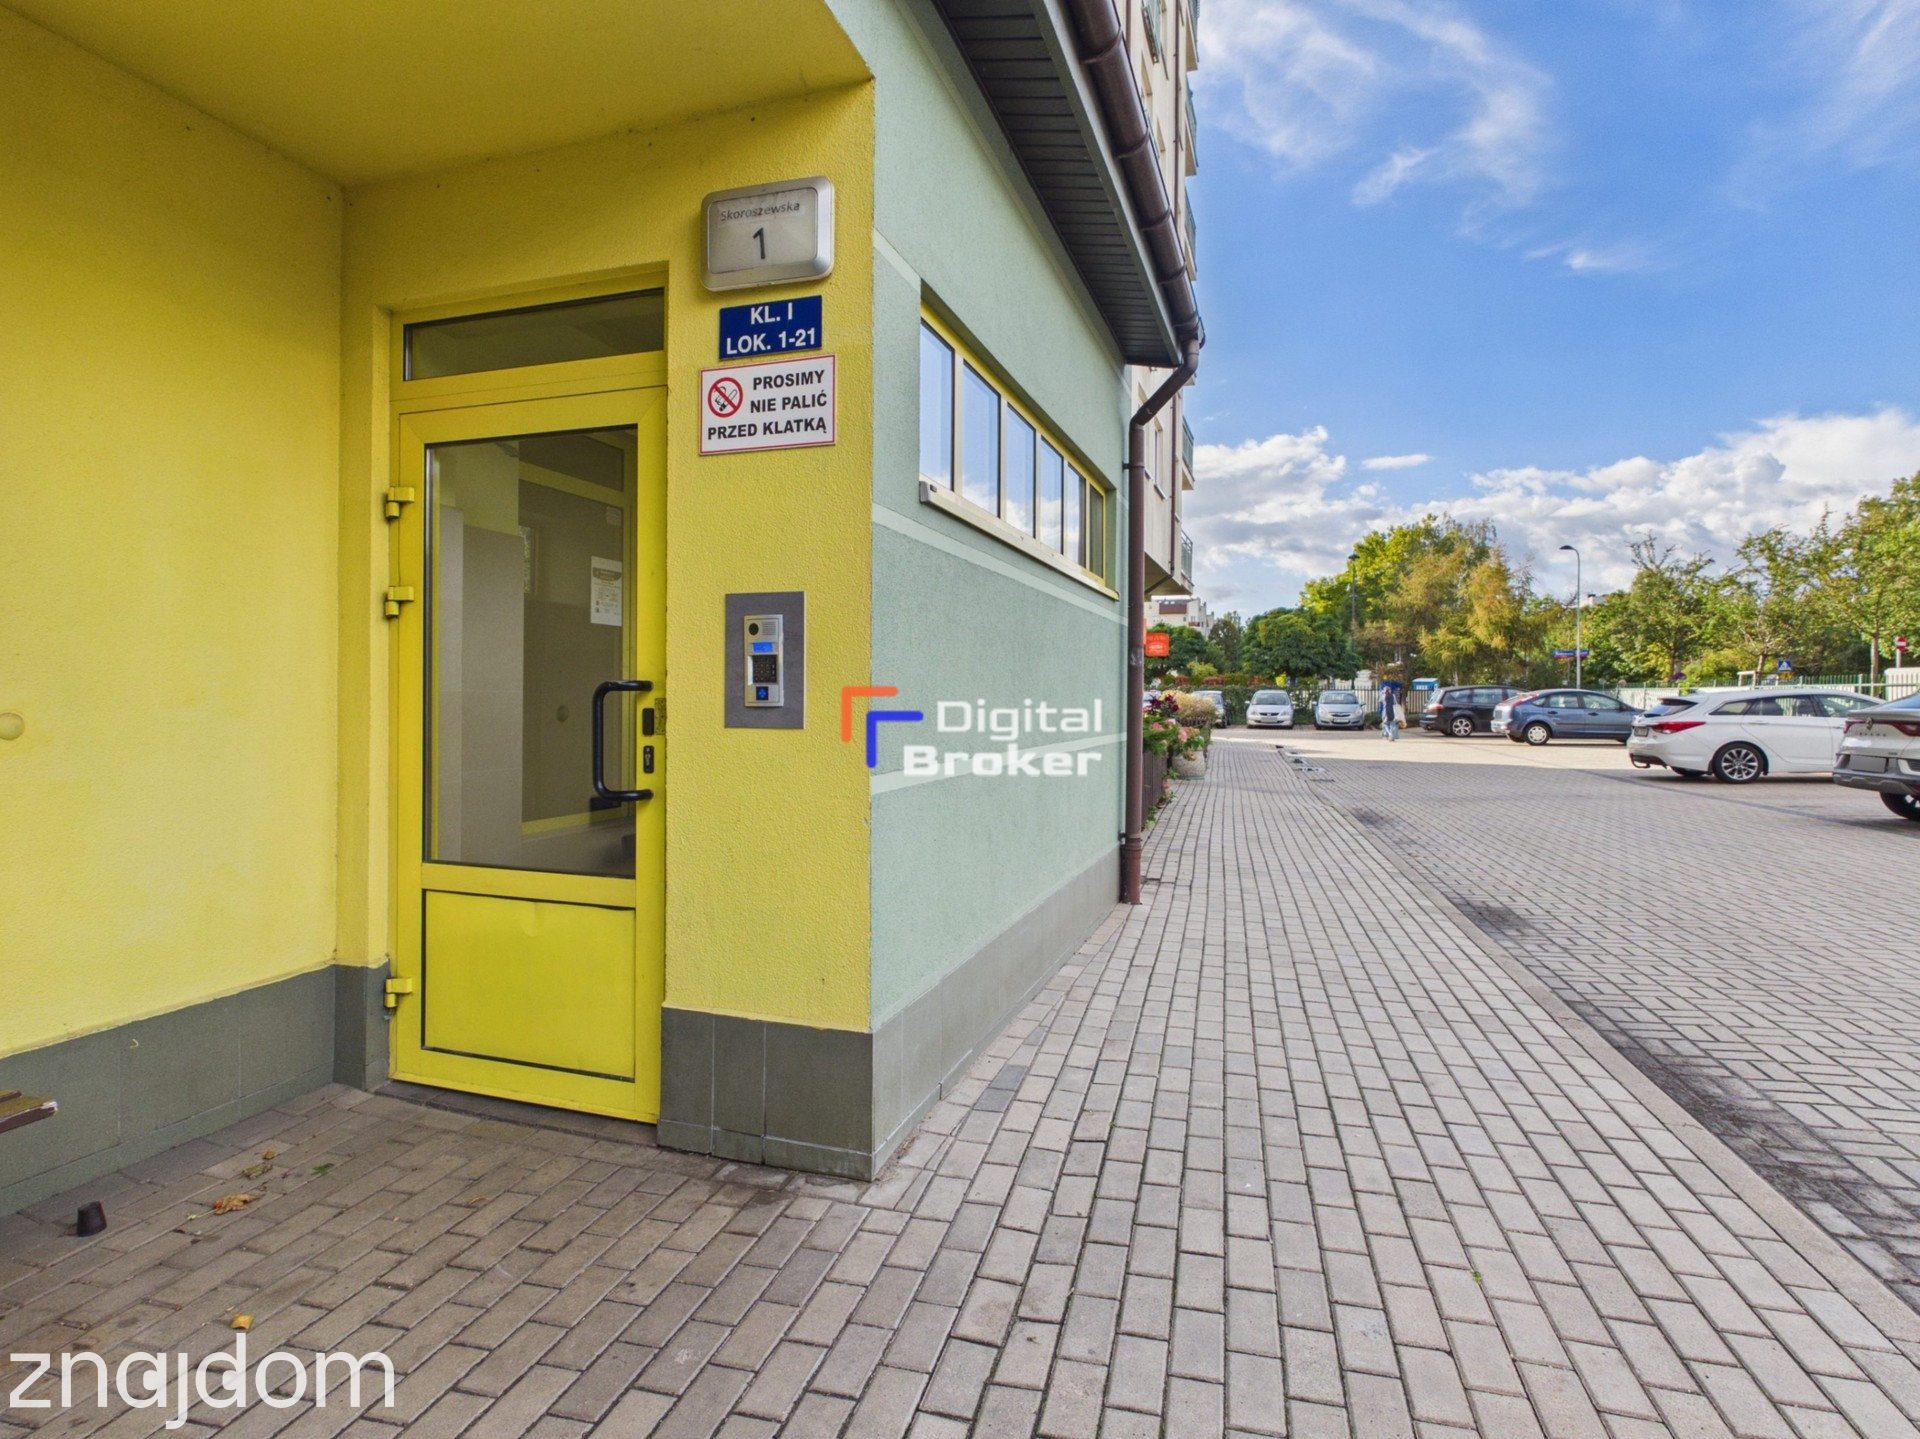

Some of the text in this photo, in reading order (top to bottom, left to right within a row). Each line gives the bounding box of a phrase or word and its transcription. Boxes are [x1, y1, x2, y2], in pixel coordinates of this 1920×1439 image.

[752, 227, 766, 260] 1
[750, 304, 781, 325] KL.
[726, 327, 816, 355] LOK. 1-21
[752, 369, 826, 391] PROSIMY
[750, 390, 828, 413] NIE PALIĆ
[707, 416, 828, 441] PRZED KLATKĄ
